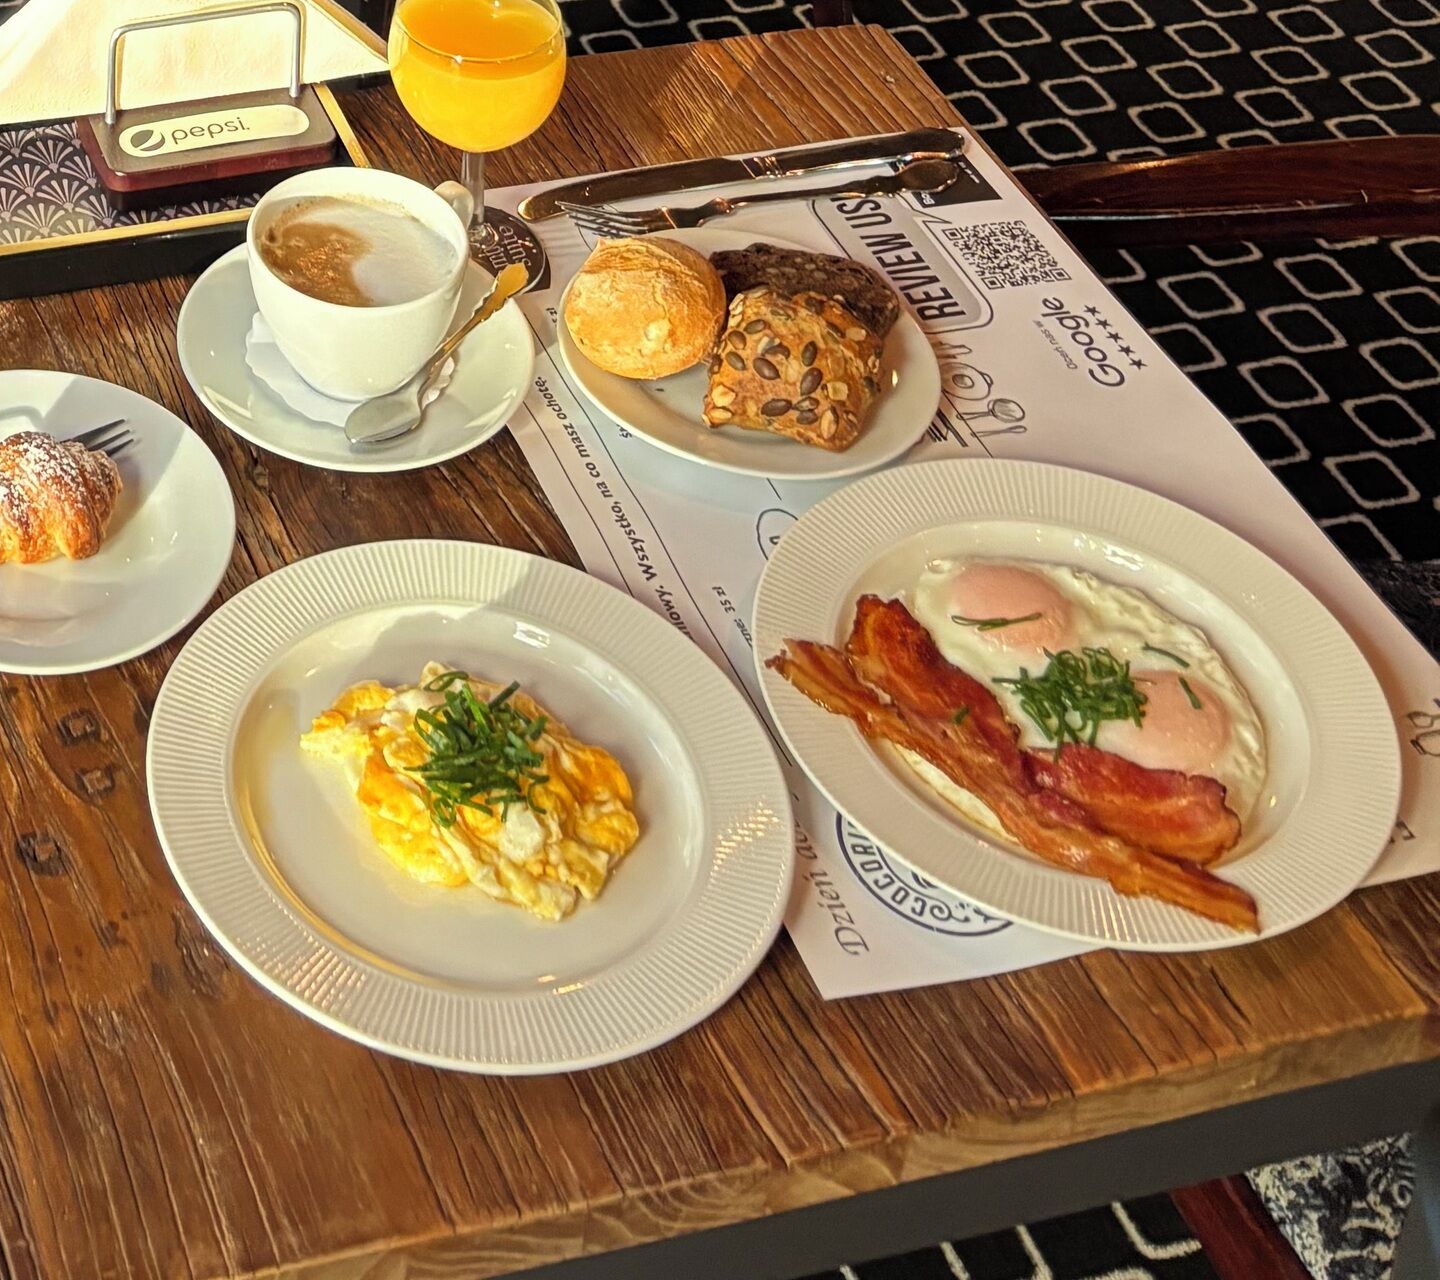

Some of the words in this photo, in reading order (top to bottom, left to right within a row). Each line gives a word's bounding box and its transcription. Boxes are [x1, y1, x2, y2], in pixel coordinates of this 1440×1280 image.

[859, 232, 967, 321] REVIEW
[1041, 327, 1061, 350] nas
[1041, 296, 1125, 387] Google
[1054, 345, 1079, 370] Oceń
[533, 376, 571, 420] ochotę.
[562, 423, 591, 459] masz
[584, 461, 602, 478] co
[595, 481, 614, 499] na
[609, 500, 658, 582] Wszystko,
[718, 598, 737, 614] 35
[847, 821, 928, 917] COCORI
[803, 870, 870, 955] Dzień
